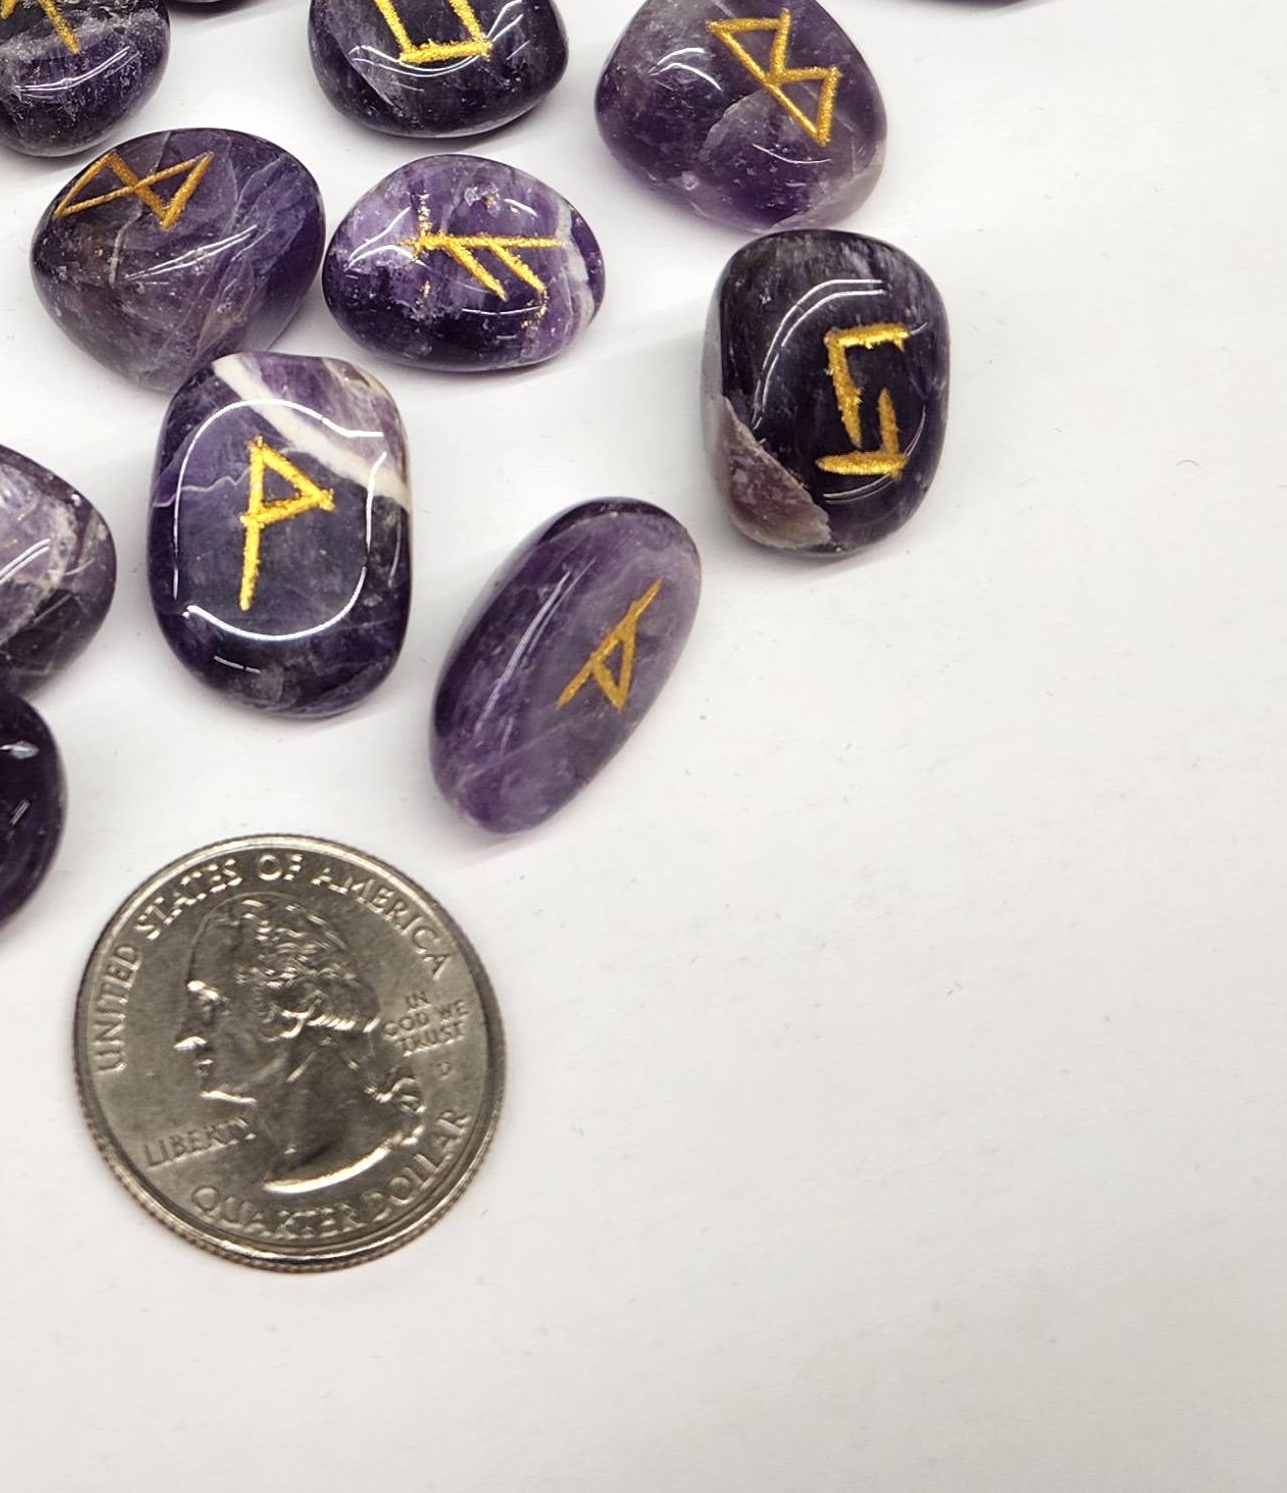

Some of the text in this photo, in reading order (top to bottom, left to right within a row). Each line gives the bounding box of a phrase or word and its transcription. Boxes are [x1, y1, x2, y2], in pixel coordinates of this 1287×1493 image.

[91, 852, 454, 1076] UNITED STATES OF AMERICA
[405, 992, 431, 1014] IN
[434, 999, 469, 1024] WE
[401, 1021, 465, 1058] TRUST
[143, 1115, 256, 1170] LIBERTY
[191, 1109, 472, 1240] QUARTER DOLLAR
